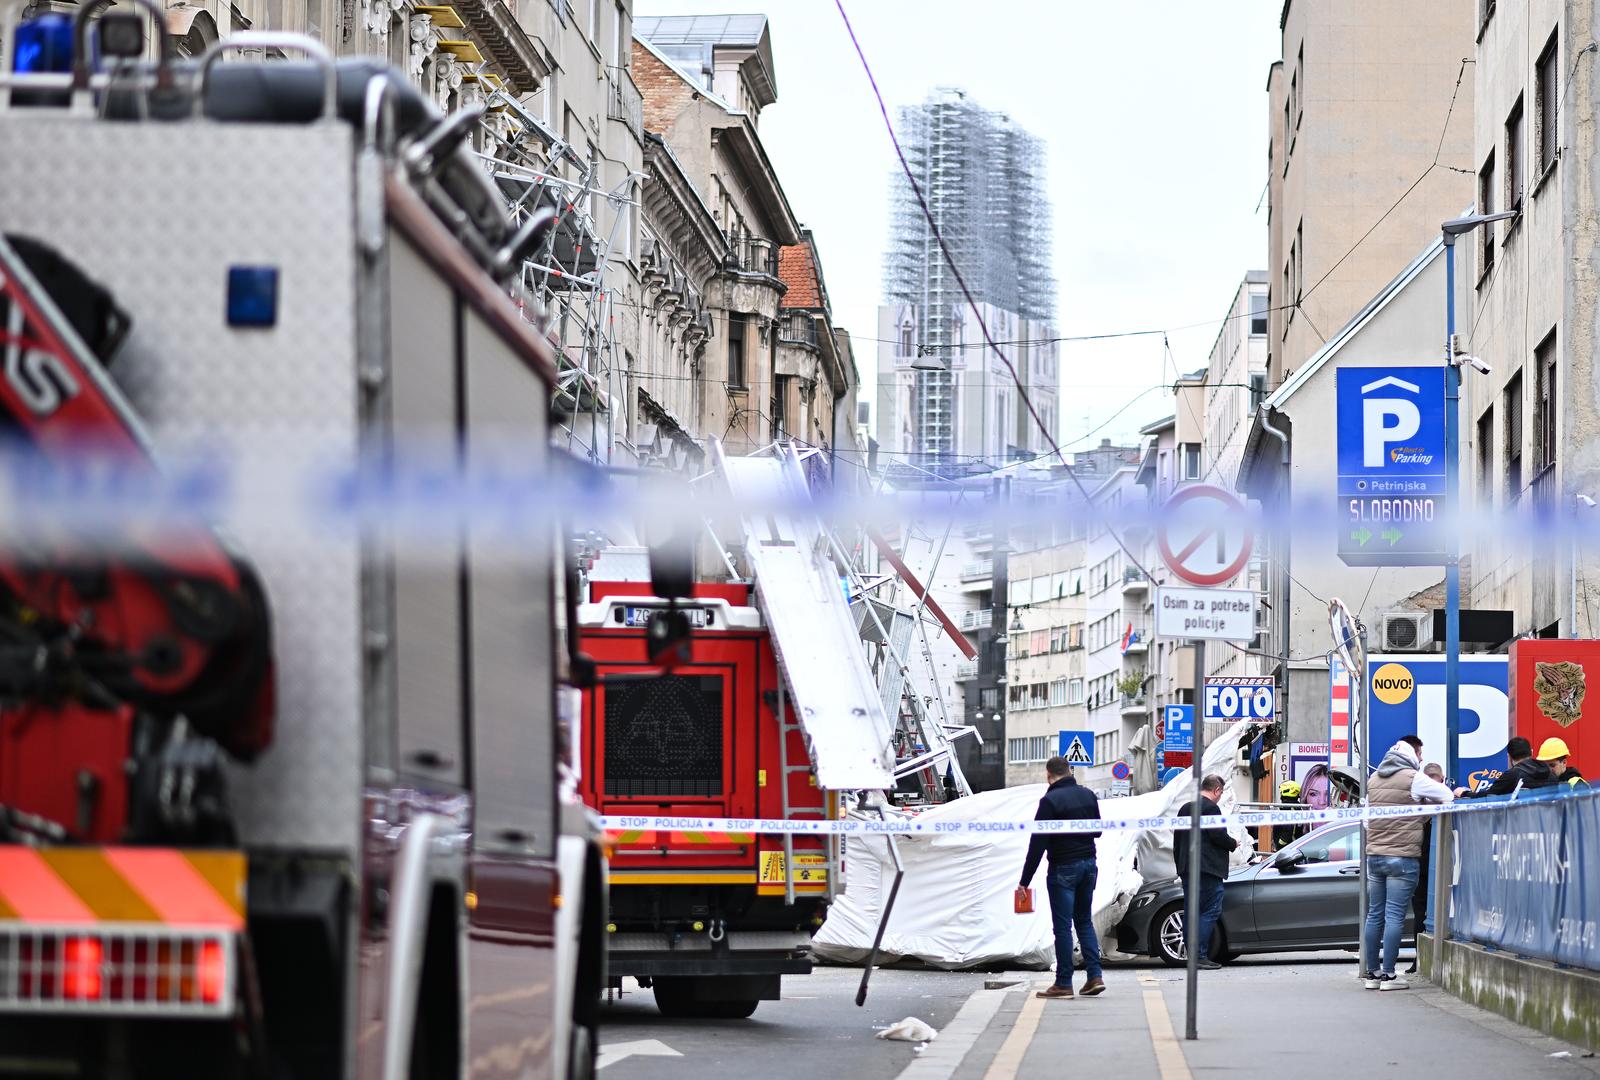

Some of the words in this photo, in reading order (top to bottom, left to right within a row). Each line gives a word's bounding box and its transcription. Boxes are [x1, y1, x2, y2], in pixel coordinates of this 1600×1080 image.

[1363, 398, 1421, 467] P
[1395, 454, 1433, 465] Parking
[1371, 480, 1427, 492] Petrinjska
[1350, 499, 1434, 522] SLOBODNO
[1163, 595, 1188, 609] Osim
[1194, 599, 1205, 610] za
[1211, 599, 1250, 613] potrebe
[1184, 616, 1226, 632] policije
[1374, 678, 1412, 690] NOVO!
[1205, 686, 1273, 717] FOTO
[1168, 708, 1184, 731] P
[1417, 684, 1509, 783] P
[1238, 815, 1265, 824] STOP
[1271, 811, 1316, 822] POLICIJA
[1337, 808, 1363, 818] STOP
[1368, 806, 1414, 817] POLICIJA
[620, 817, 648, 828] STOP
[655, 818, 703, 828] POLICIJA
[726, 820, 755, 830] STOP
[761, 821, 808, 831] POLICIJA
[831, 822, 858, 831] STOP
[865, 822, 912, 832] POLICIJA
[934, 822, 962, 832] STOP
[968, 822, 1015, 832] POLICIJA
[1037, 821, 1064, 831] STOP
[1070, 820, 1117, 830] POLICIJA
[1138, 819, 1165, 828] STOP
[1171, 817, 1217, 827] POLIJA
